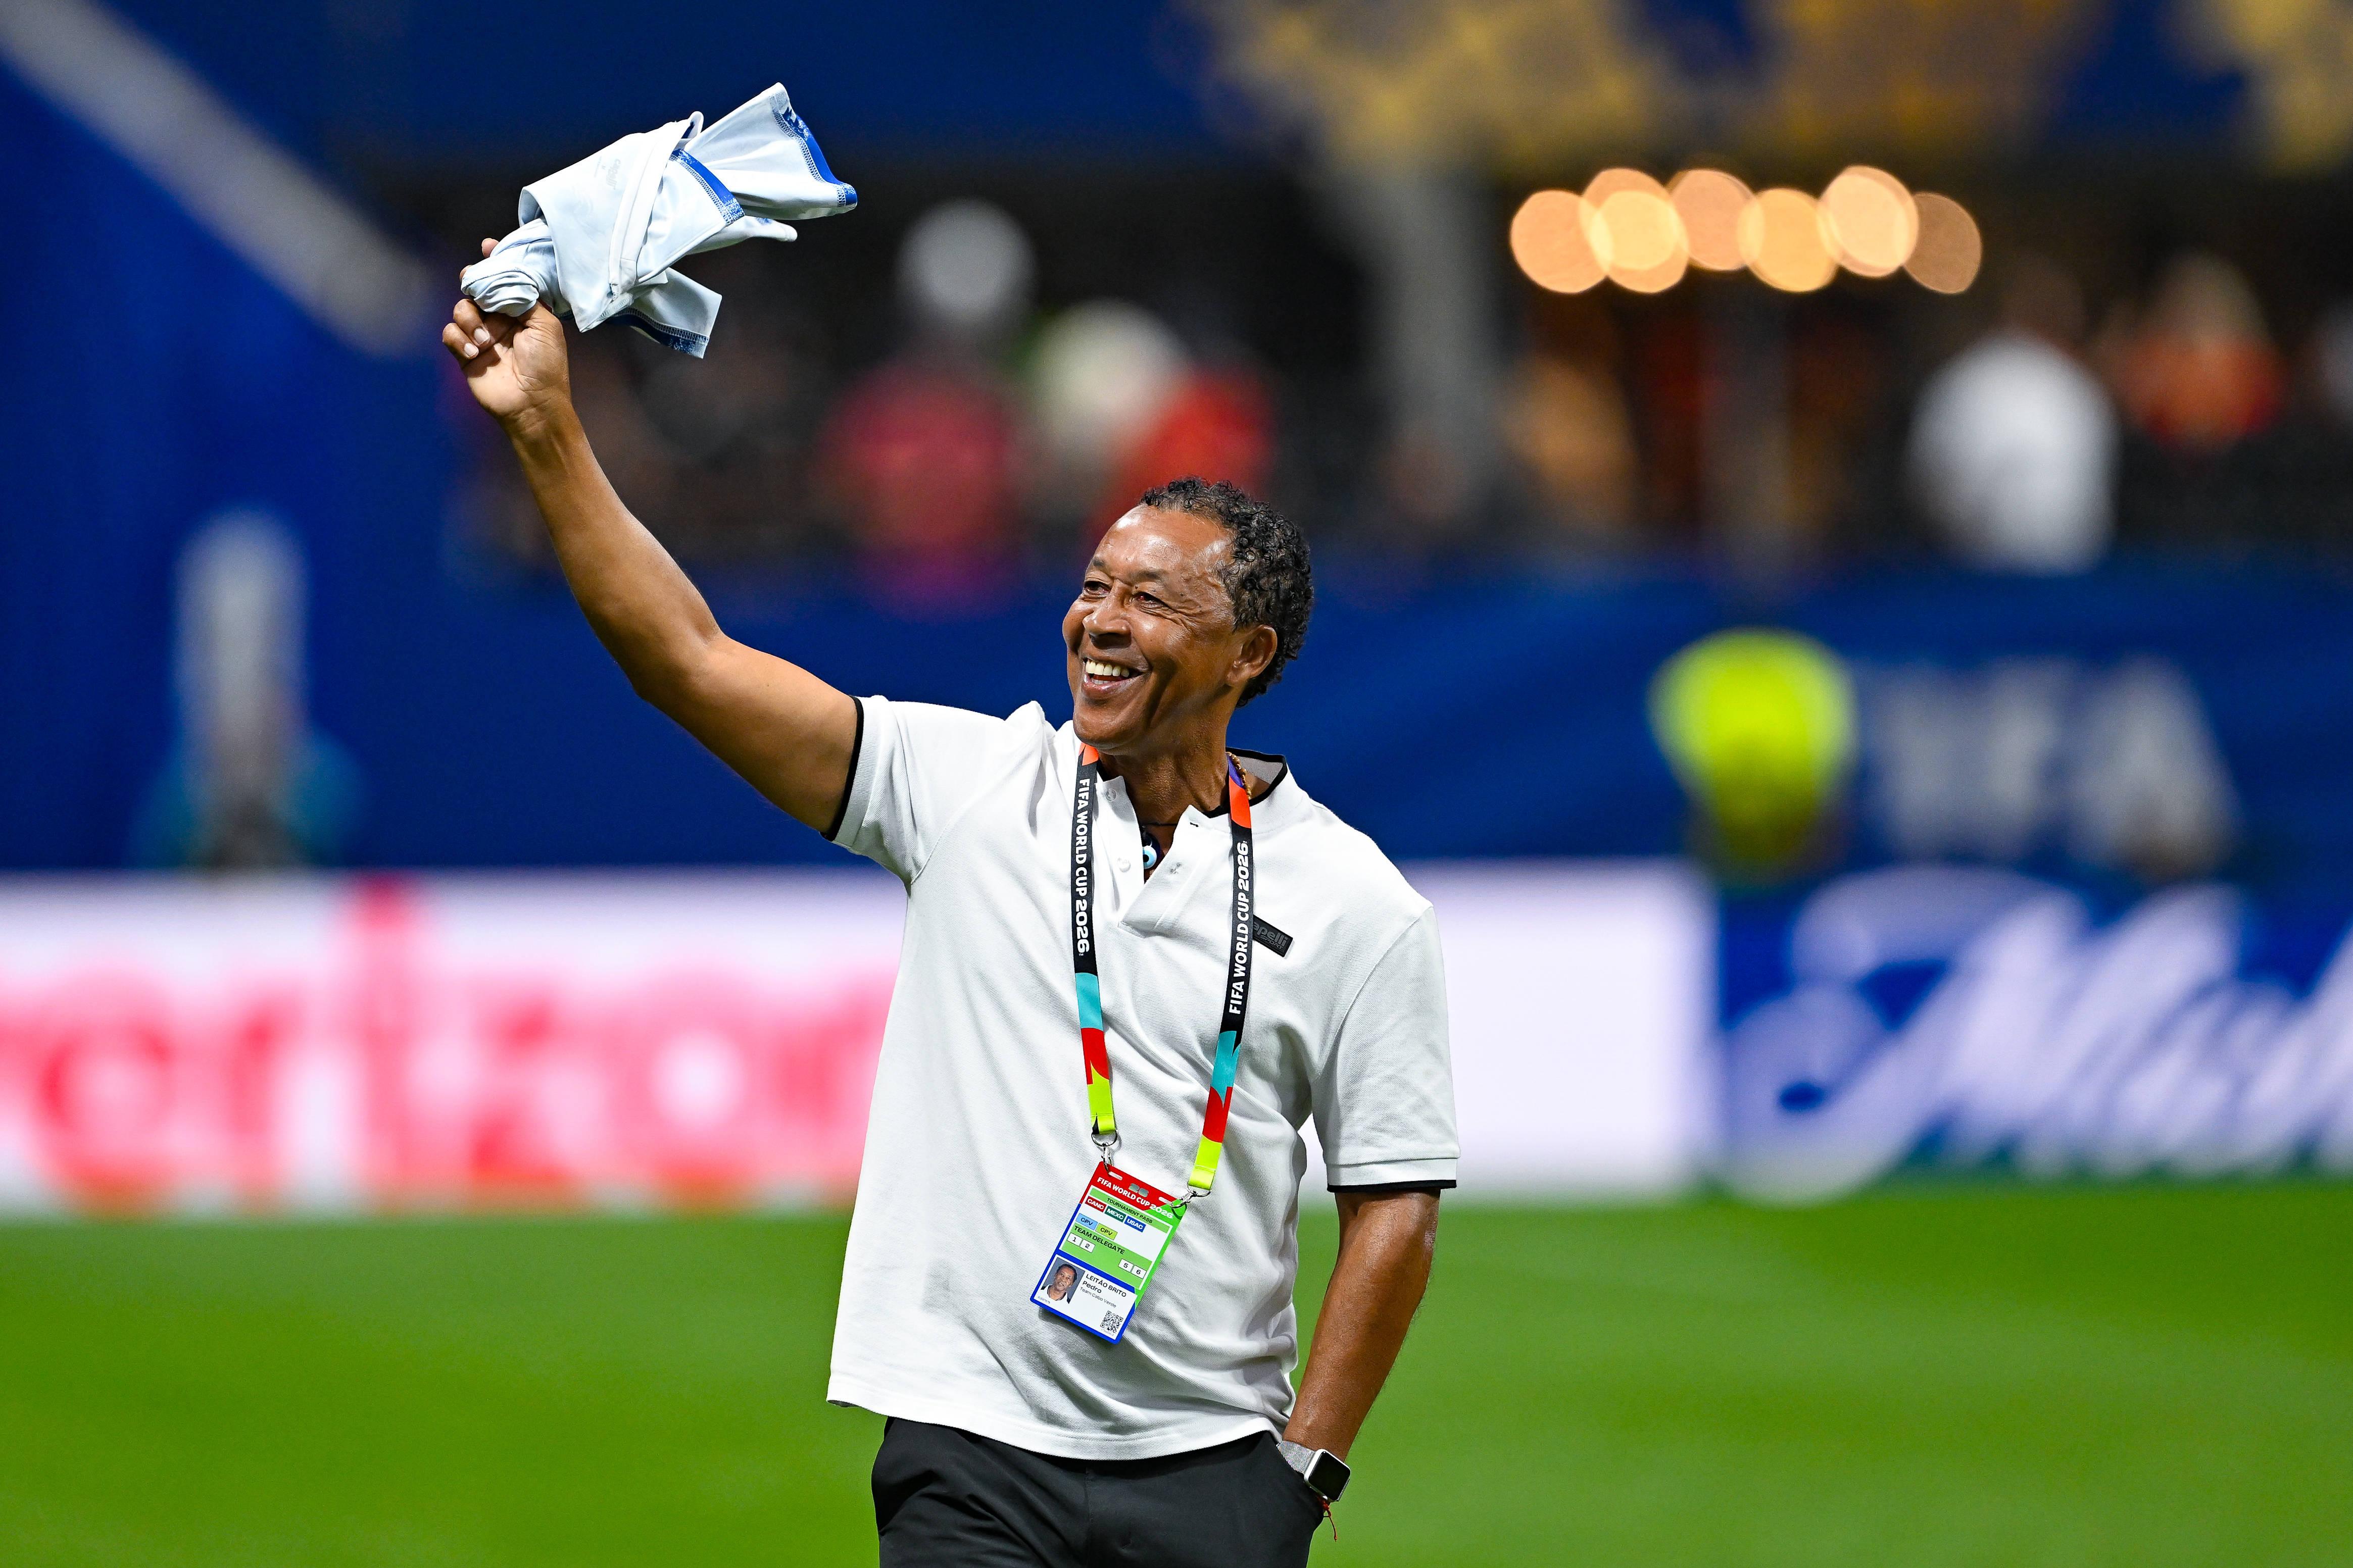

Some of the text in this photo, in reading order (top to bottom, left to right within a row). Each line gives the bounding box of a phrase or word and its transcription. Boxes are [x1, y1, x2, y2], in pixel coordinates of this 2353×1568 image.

[1077, 778, 1090, 810] FIFA
[1075, 811, 1088, 864] WORLD
[1075, 867, 1088, 896] CUP
[1237, 892, 1249, 921] CUP
[1253, 922, 1288, 946] apelli
[1260, 935, 1284, 949] SPORT
[1233, 923, 1249, 977] WORLD
[1229, 981, 1245, 1015] FIFA
[1097, 1177, 1173, 1219] FIFA WORLD CUP 2026
[1107, 1198, 1153, 1224] TOURNAMENT PASS
[1081, 1218, 1113, 1236] CPV CPV
[1087, 1198, 1143, 1230] CANC MEXC USAC
[1074, 1226, 1125, 1255] TEAM DELEGATE
[1080, 1287, 1116, 1308] Team Cabo Verde
[1083, 1281, 1102, 1293] Pedro
[1086, 1274, 1126, 1297] LEITÃO BRITO
